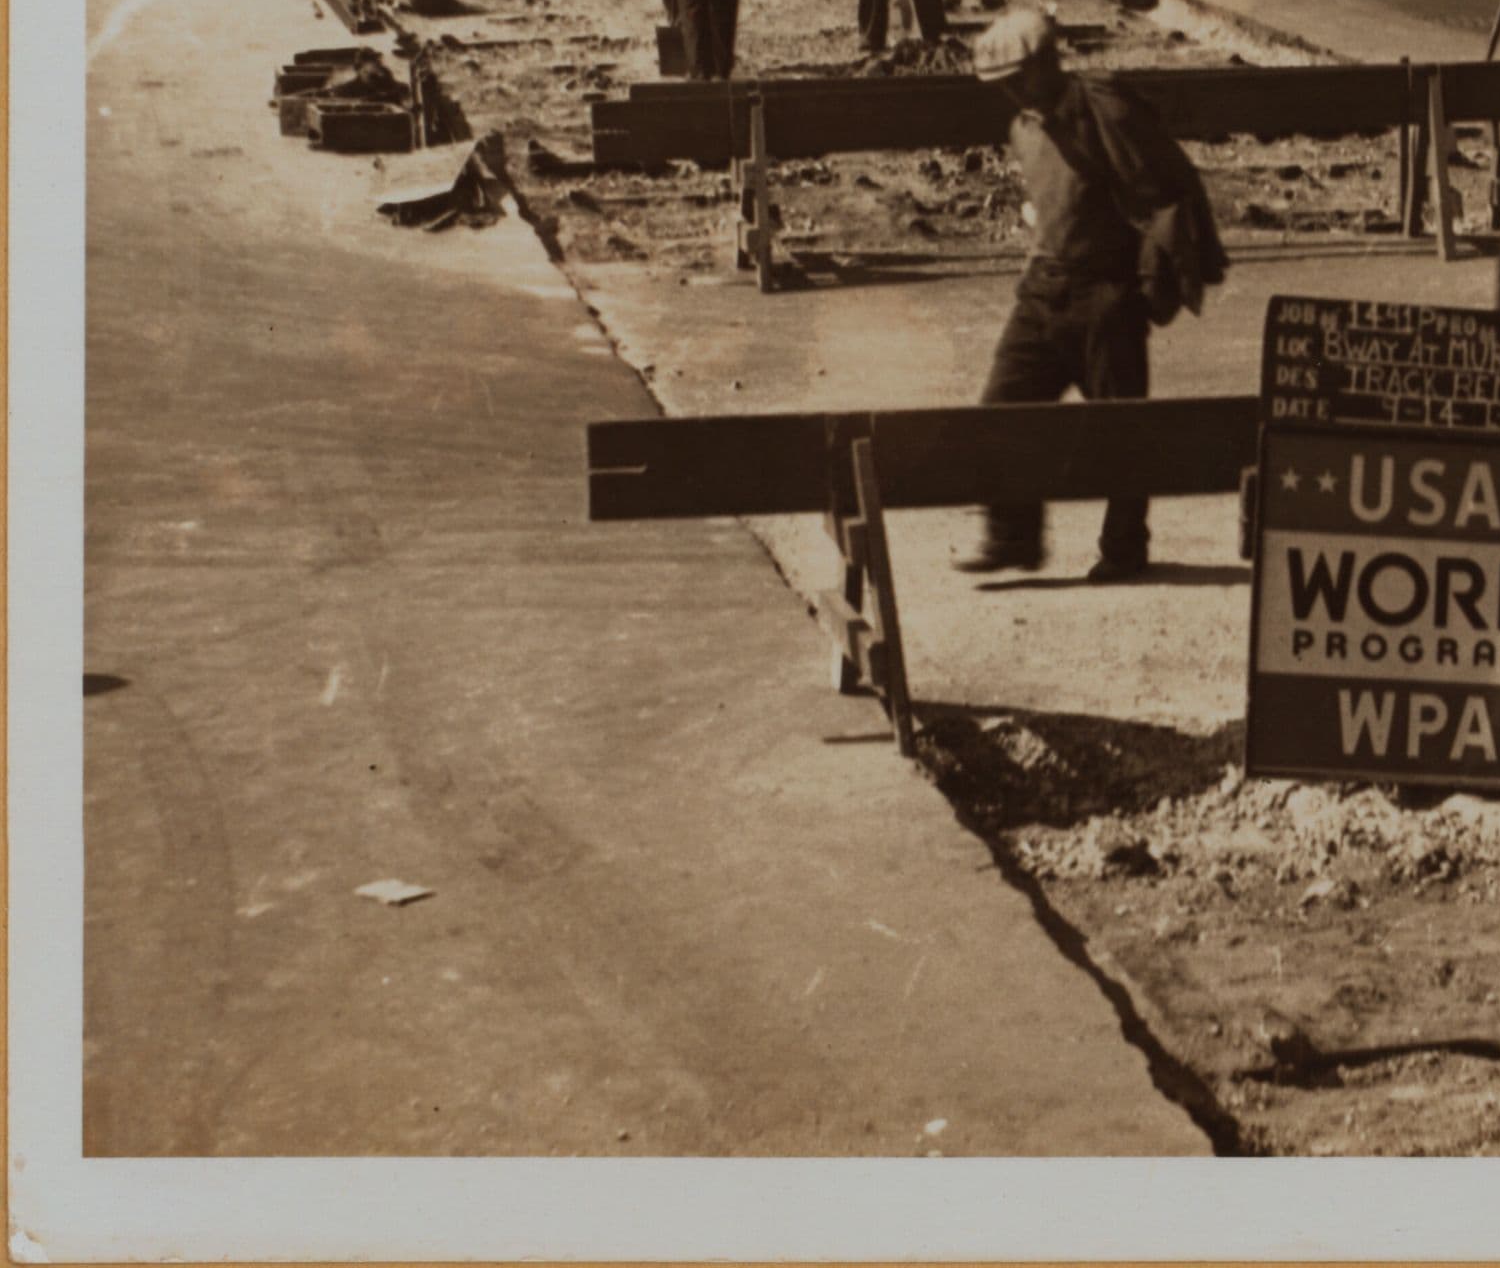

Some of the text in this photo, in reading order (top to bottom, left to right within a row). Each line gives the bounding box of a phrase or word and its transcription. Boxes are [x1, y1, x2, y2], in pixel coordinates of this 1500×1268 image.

[1275, 364, 1318, 390] DES
[1345, 363, 1438, 401] TRACK
[1271, 395, 1330, 419] DATE
[1338, 689, 1498, 763] WPA
